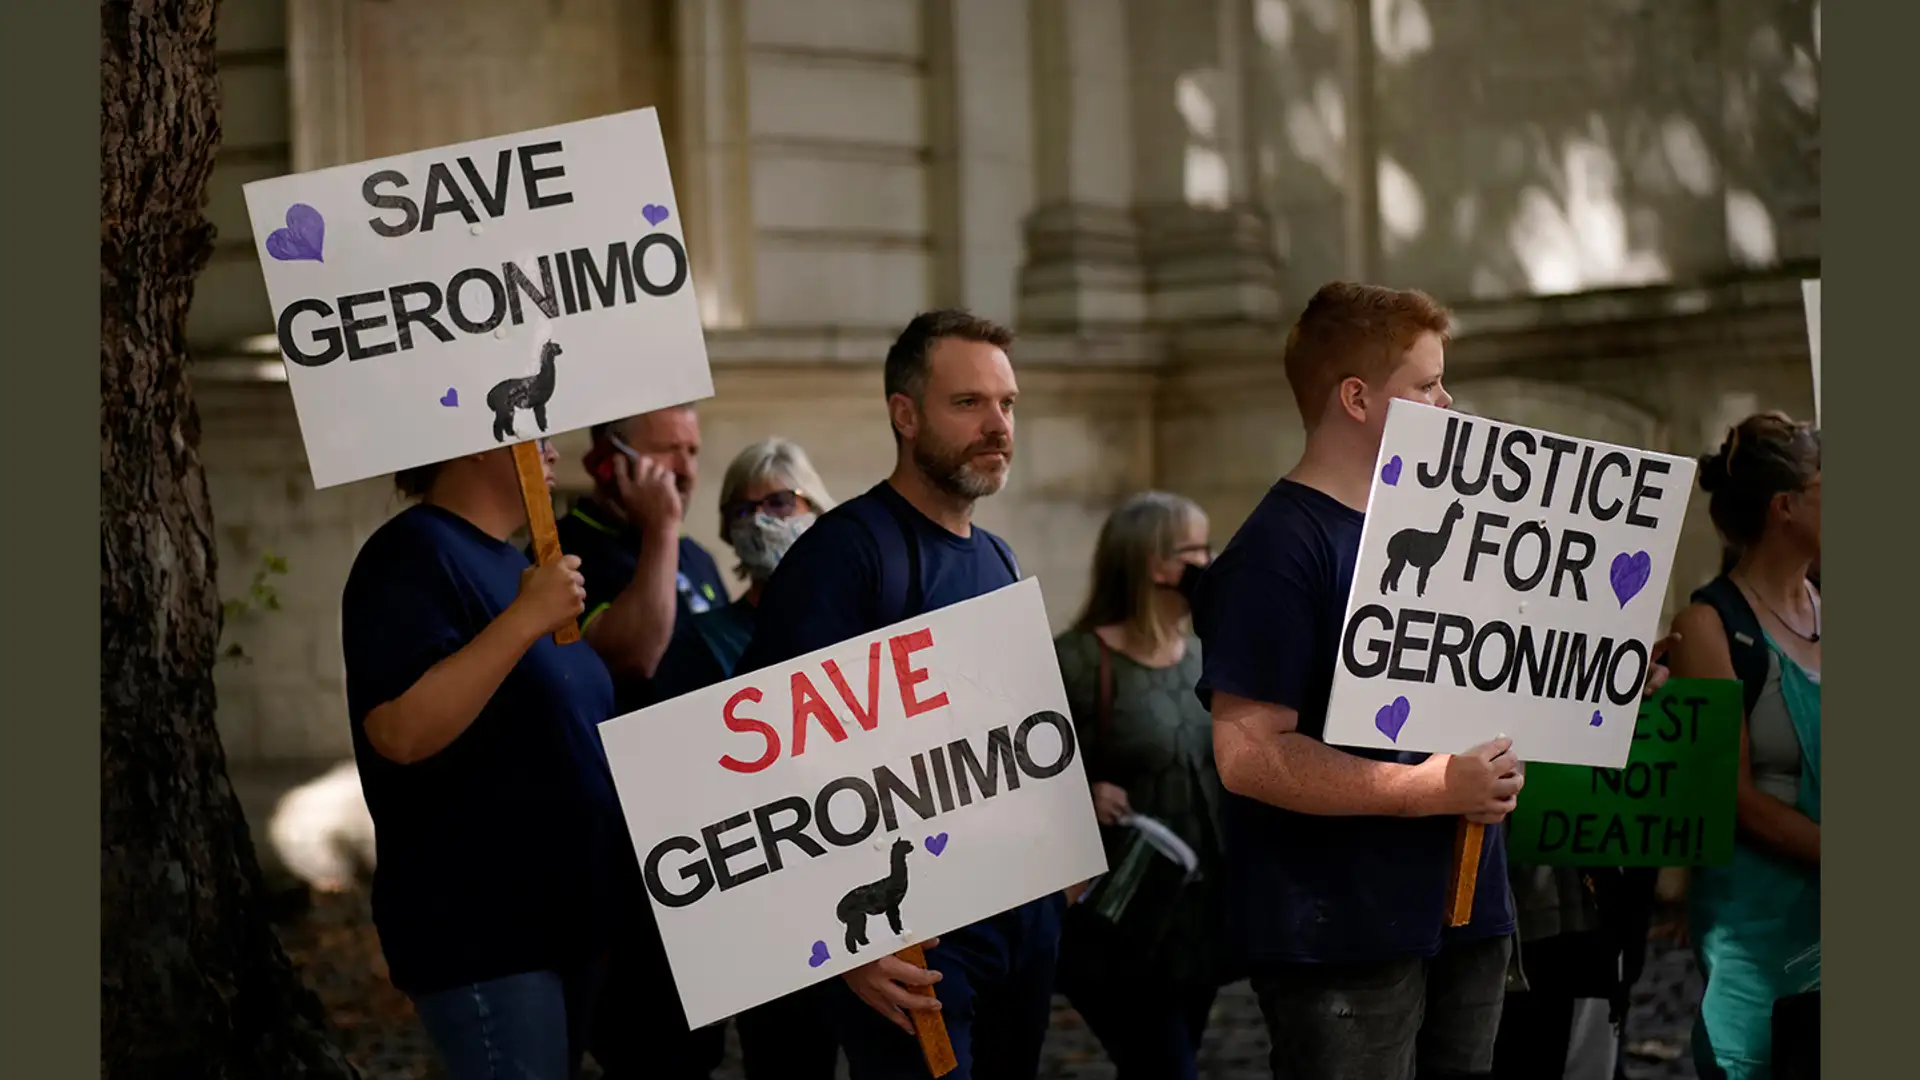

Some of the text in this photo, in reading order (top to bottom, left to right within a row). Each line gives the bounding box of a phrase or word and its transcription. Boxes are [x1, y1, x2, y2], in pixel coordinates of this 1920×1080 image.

[362, 141, 574, 237] SAVE
[278, 233, 687, 367] GERONIMO
[1416, 417, 1671, 529] JUSTICE
[1463, 511, 1597, 602] FOR
[718, 627, 950, 773] SAVE
[1342, 604, 1648, 706] GERONIMO
[1632, 696, 1709, 744] EST
[644, 710, 1075, 908] GERONIMO
[1591, 761, 1678, 798] NOT
[1536, 810, 1705, 860] DEATH!
